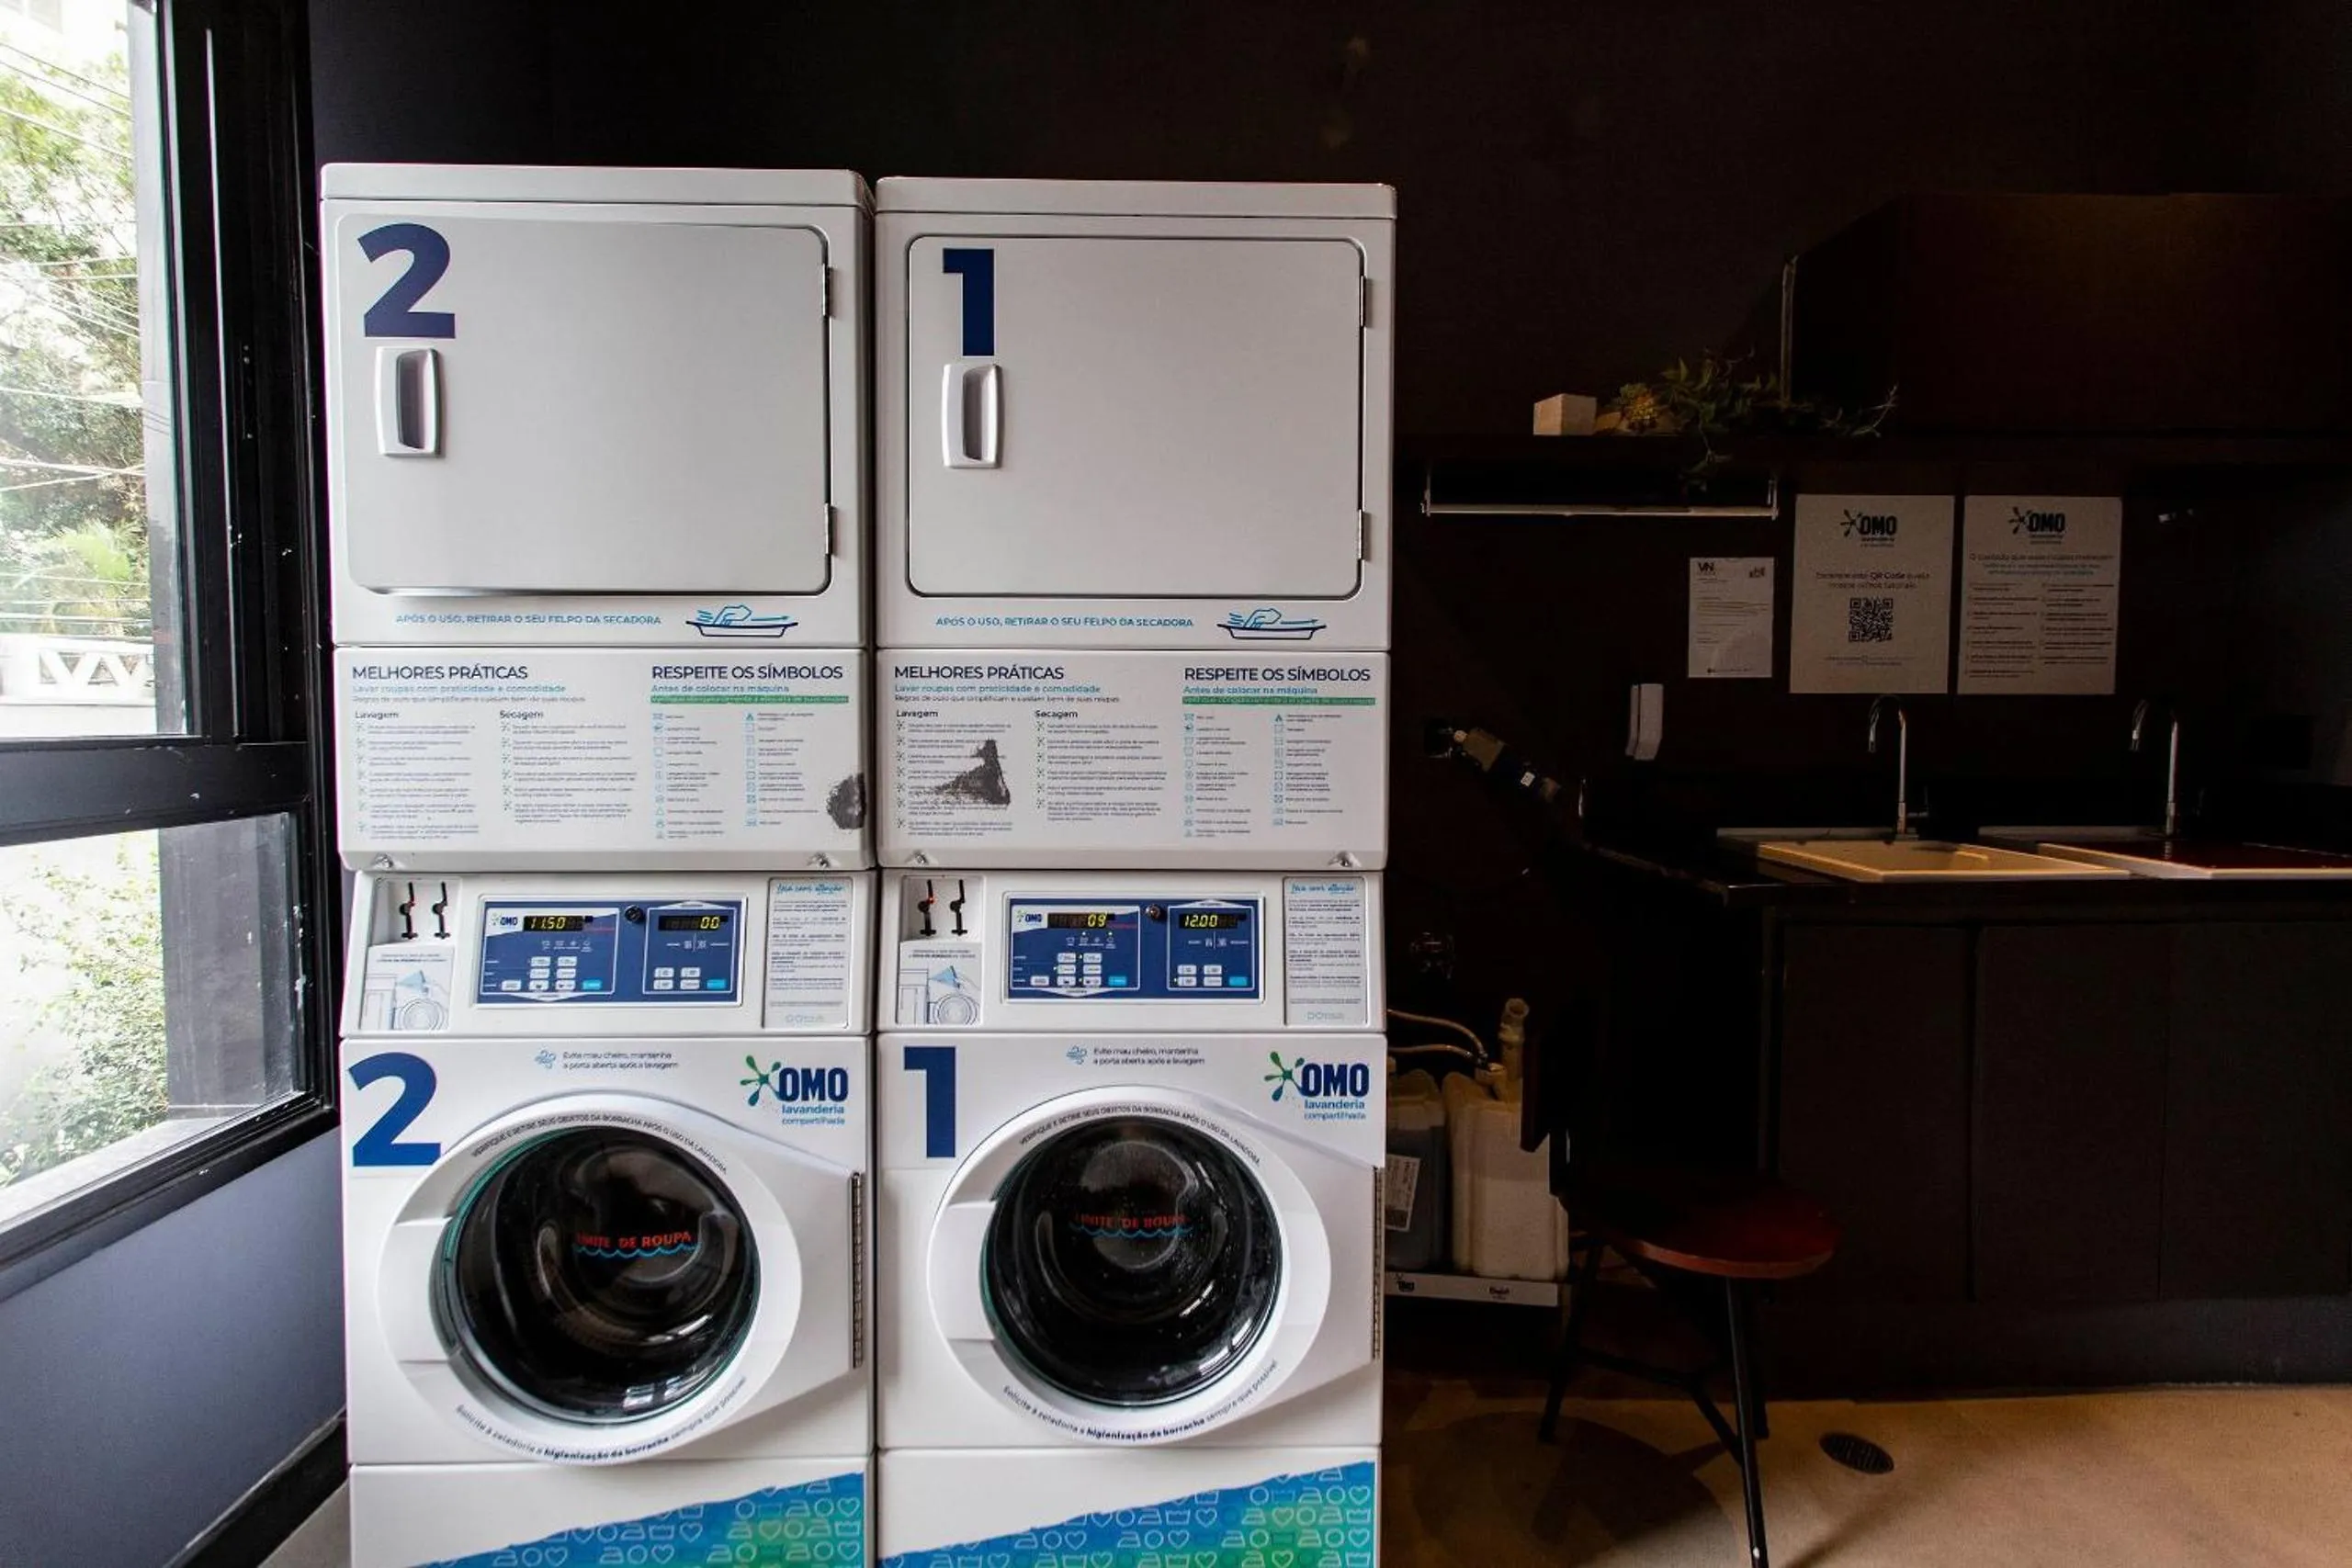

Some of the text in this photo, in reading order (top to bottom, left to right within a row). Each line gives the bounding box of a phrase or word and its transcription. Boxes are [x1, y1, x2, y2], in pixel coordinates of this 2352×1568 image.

[357, 222, 456, 339] 2
[942, 247, 995, 356] 1
[1859, 515, 1897, 536] OMO
[2028, 513, 2065, 533] OMO
[429, 615, 437, 625] O
[467, 615, 512, 625] RETIRAR
[514, 615, 524, 625] O
[526, 615, 546, 625] SEU
[548, 615, 582, 625] FELPO
[585, 615, 602, 625] DA
[604, 615, 662, 625] SECADORA
[936, 615, 965, 626] APÓS
[967, 617, 976, 626] O
[1004, 617, 1048, 626] RETIRAR
[1050, 617, 1059, 626] O
[1061, 618, 1081, 626] SEU
[1084, 618, 1117, 626] FELPO
[1119, 618, 1135, 626] DA
[1136, 618, 1193, 626] SECADORA
[353, 663, 527, 680] MELHORES PRÁTICAS
[652, 663, 842, 680] RESPEITE OS SÍMBOLOS
[894, 663, 1064, 680] MELHORES PRÁTICAS
[1184, 665, 1370, 682] RESPEITE OS SÍMBOLOS
[440, 684, 495, 694] praticidade
[506, 684, 566, 693] comodidade
[650, 684, 679, 693] Antes
[681, 684, 694, 693] de
[695, 684, 730, 693] colocar
[922, 685, 954, 694] roupas
[979, 684, 1033, 694] praticidade
[1043, 684, 1100, 693] comodidade
[1183, 686, 1211, 694] Antes
[1213, 686, 1225, 694] de
[1227, 686, 1261, 694] colocar
[1277, 686, 1317, 696] máquina
[356, 710, 399, 721] Lavagem
[500, 710, 544, 721] Secagem
[896, 709, 939, 720] Lavagem
[1035, 710, 1078, 721] Secagem
[700, 916, 720, 929] 00
[1087, 912, 1107, 928] 09
[778, 1066, 849, 1102] OMO
[1301, 1063, 1370, 1098] OMO
[782, 1104, 844, 1114] lavanderia
[903, 1045, 956, 1157] 1
[1305, 1099, 1365, 1110] lavanderia
[348, 1052, 441, 1167] 2
[1182, 1110, 1200, 1123] APÓS
[603, 1114, 641, 1125] BORRACHA
[618, 1236, 637, 1248] DE
[641, 1231, 692, 1247] ROUPA
[1086, 1427, 1148, 1441] higienização
[1149, 1429, 1161, 1438] da
[1163, 1417, 1205, 1436] borracha
[544, 1447, 608, 1462] higienização
[610, 1449, 623, 1458] da
[625, 1437, 669, 1455] borracha
